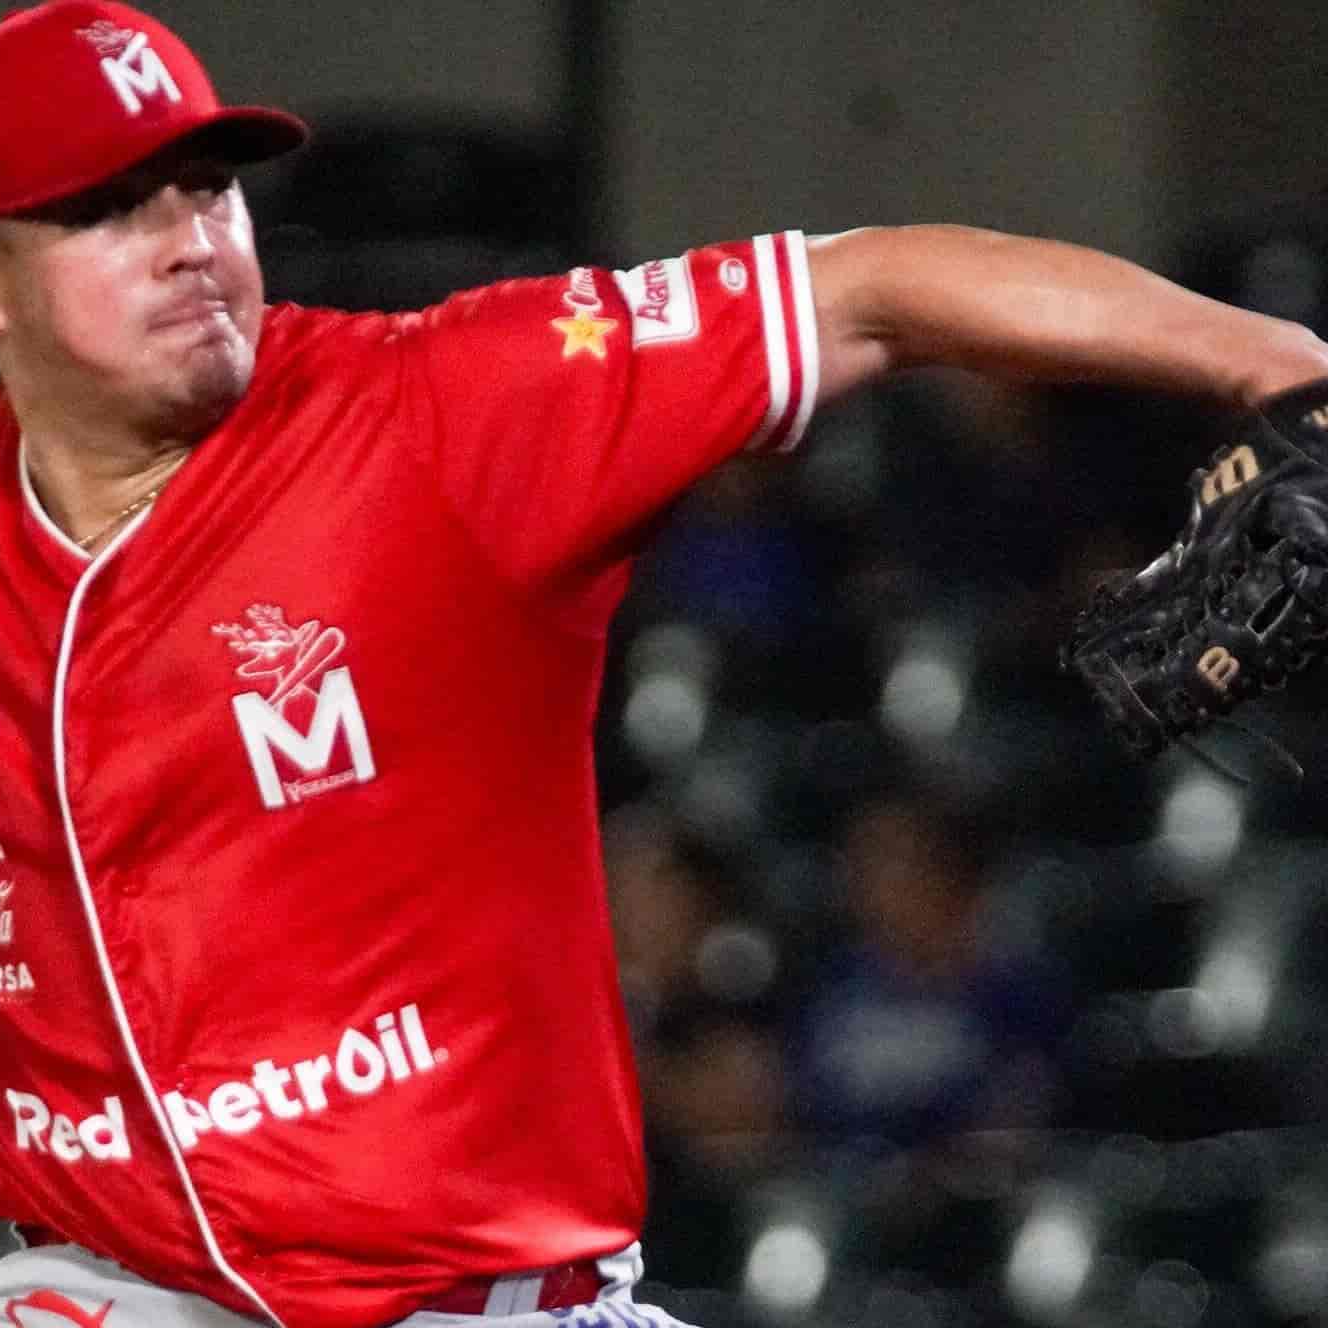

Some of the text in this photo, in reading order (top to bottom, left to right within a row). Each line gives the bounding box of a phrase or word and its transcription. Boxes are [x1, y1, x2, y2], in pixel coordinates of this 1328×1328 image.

[100, 46, 182, 117] M
[231, 665, 376, 809] M
[5, 1088, 132, 1162] Red
